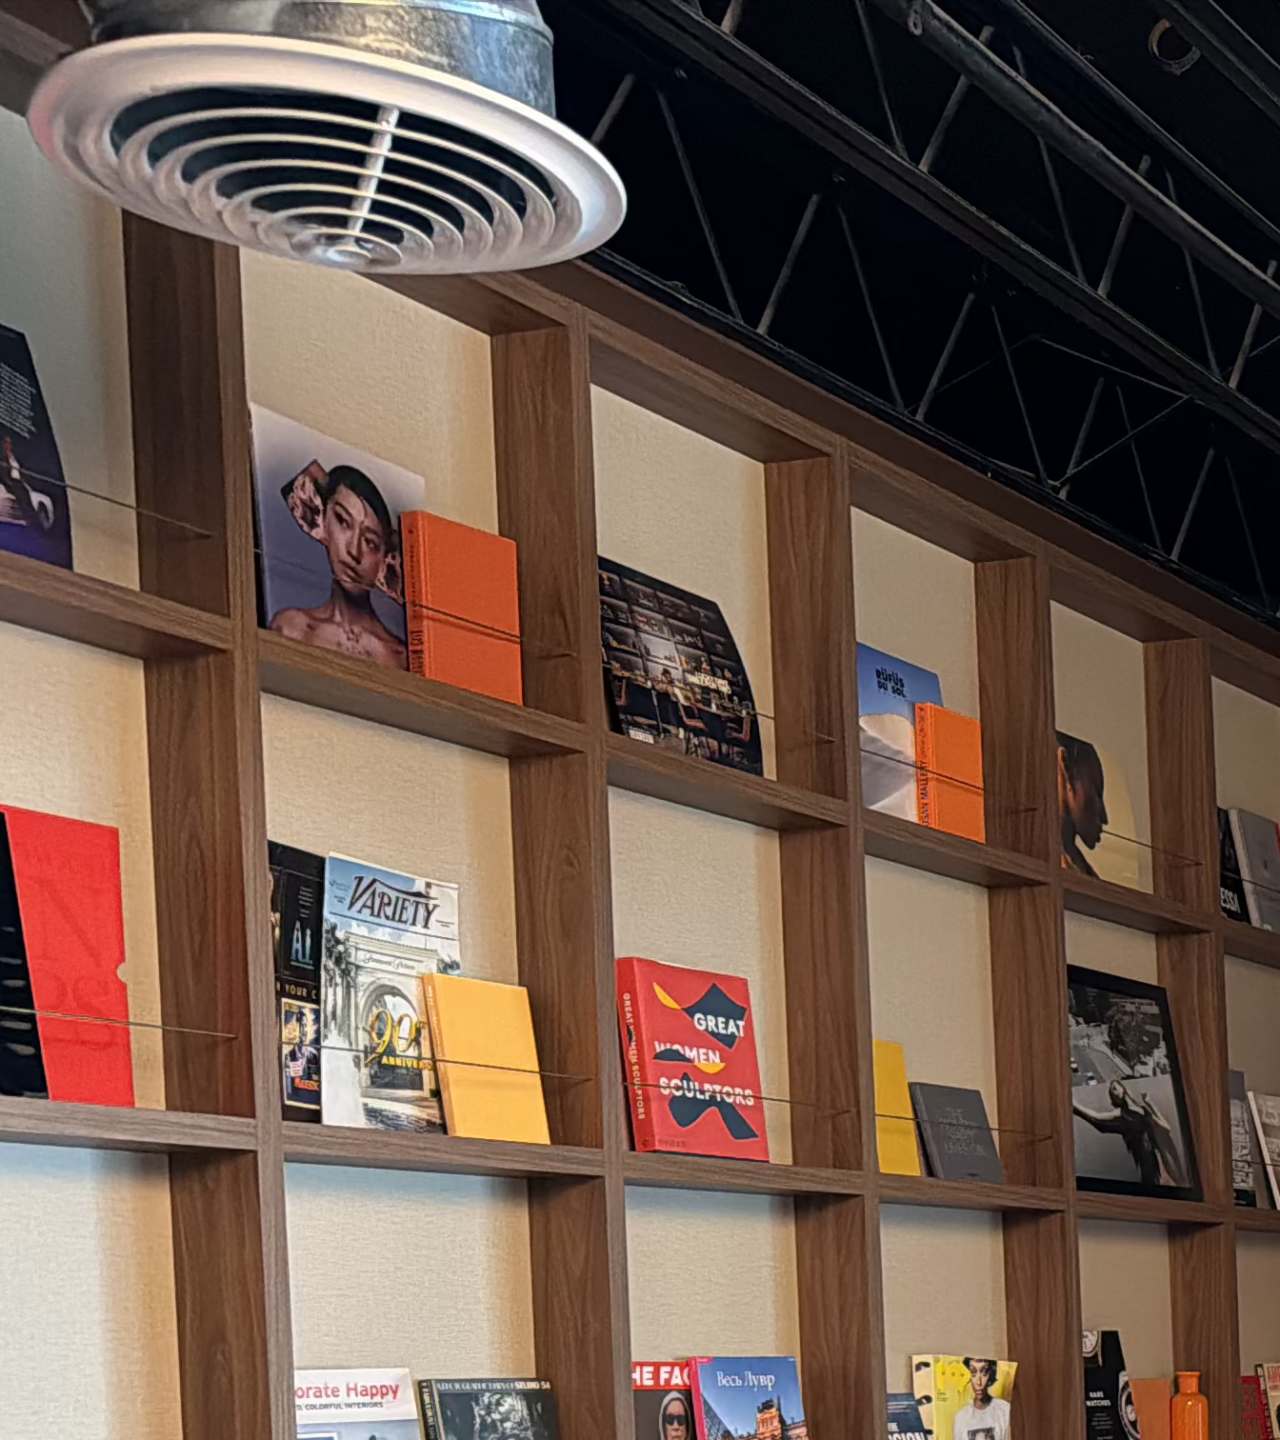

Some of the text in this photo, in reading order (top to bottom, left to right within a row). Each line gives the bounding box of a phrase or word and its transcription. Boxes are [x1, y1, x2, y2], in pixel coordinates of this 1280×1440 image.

[346, 874, 441, 932] VARIETY
[622, 992, 633, 1027] GREAT
[693, 1012, 746, 1038] GREAT
[658, 1076, 755, 1107] SCULPTORS
[346, 1382, 400, 1400] Happy
[716, 1370, 776, 1392] Весь Лувр
